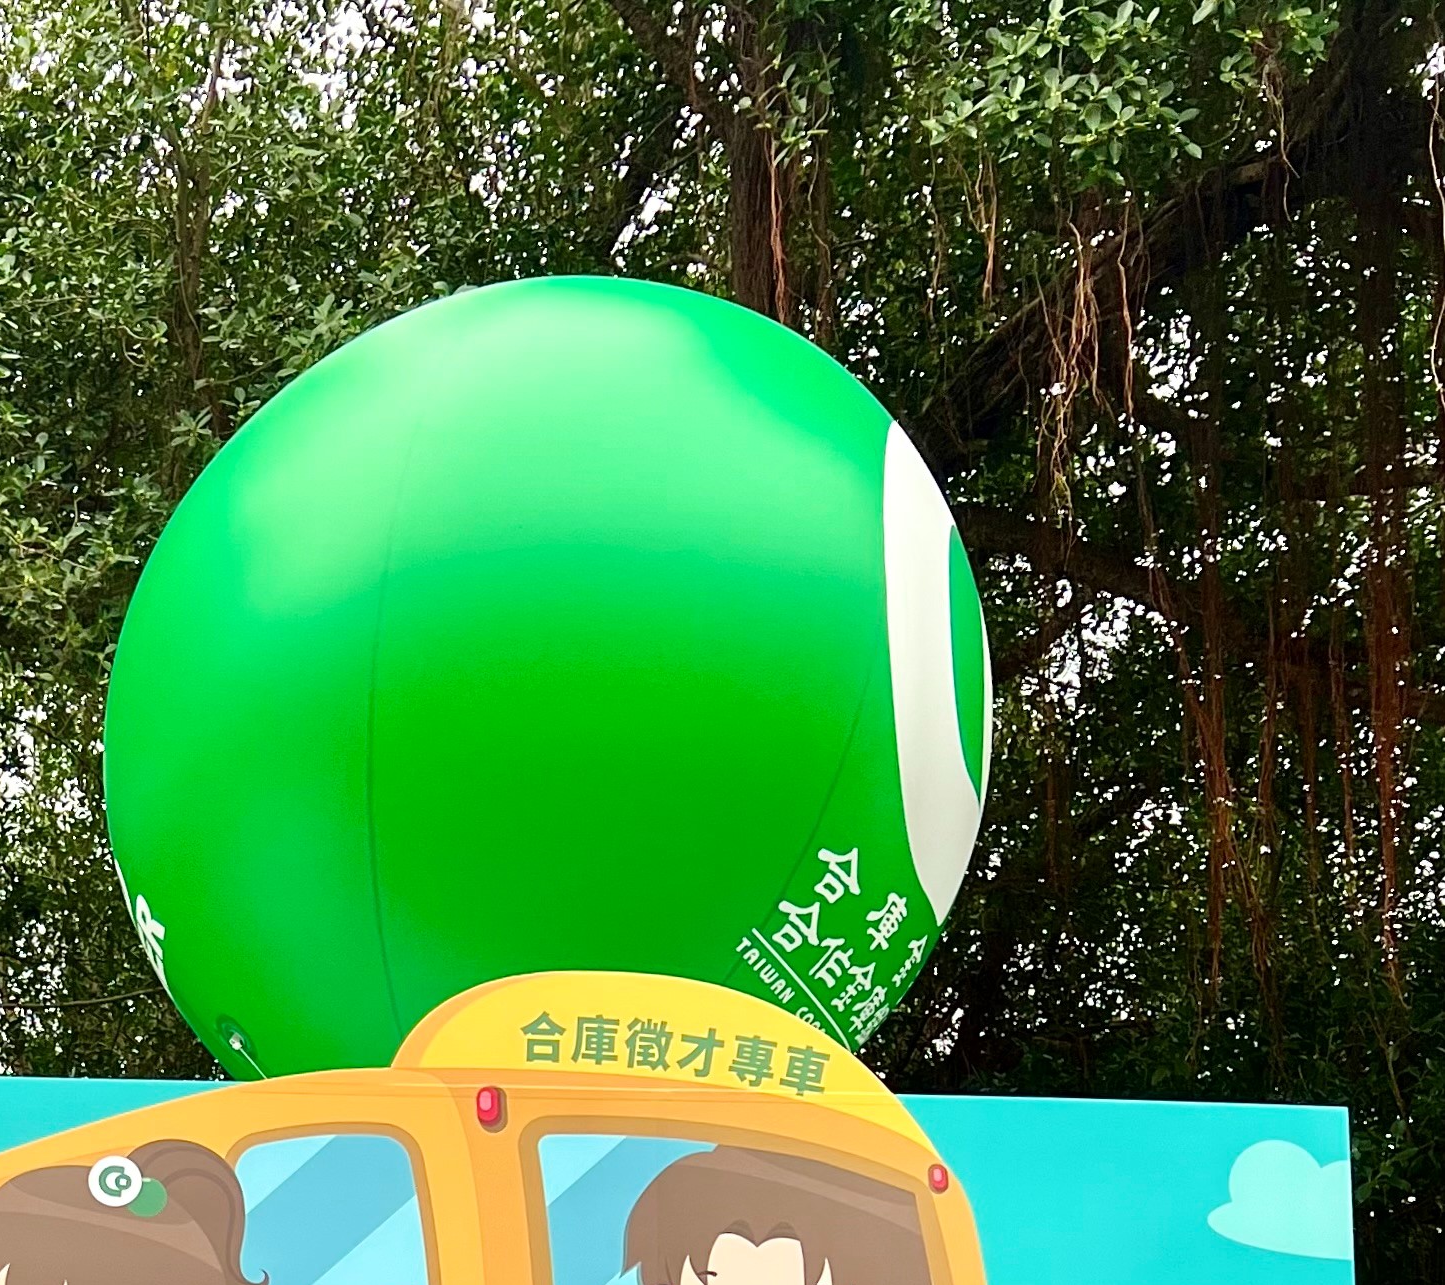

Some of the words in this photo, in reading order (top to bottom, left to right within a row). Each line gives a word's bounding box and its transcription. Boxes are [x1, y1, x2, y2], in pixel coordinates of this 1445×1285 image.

[735, 936, 796, 1004] TAIWAN
[520, 1011, 831, 1097] 合庫徵才專車
